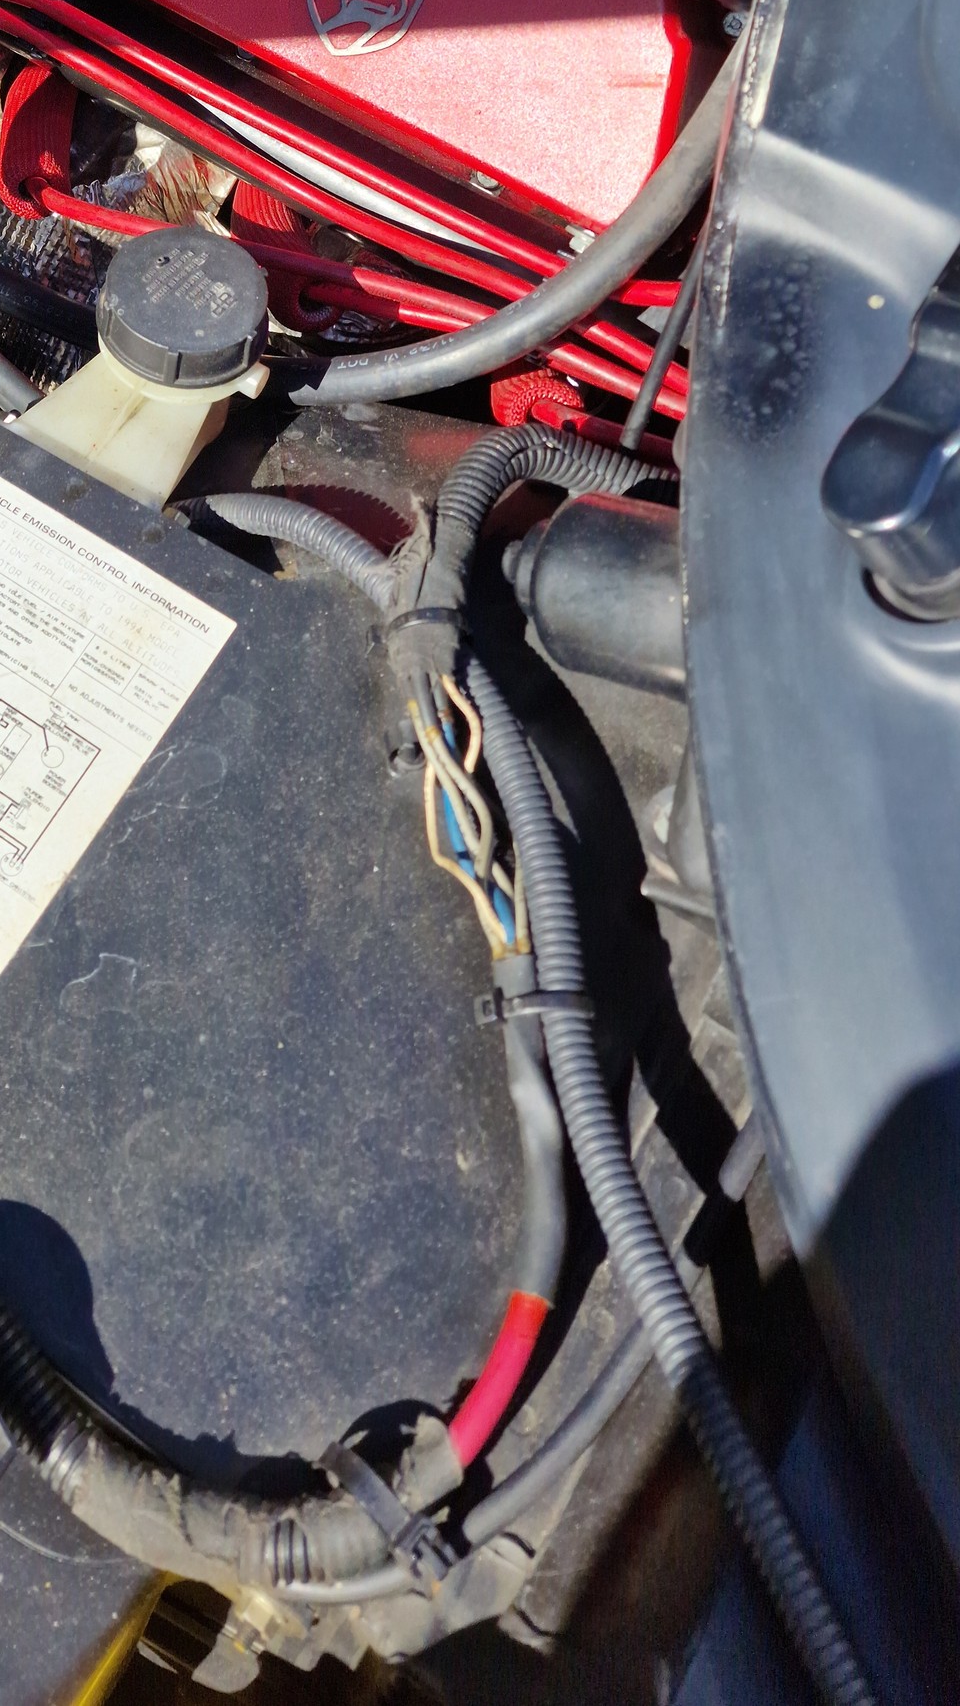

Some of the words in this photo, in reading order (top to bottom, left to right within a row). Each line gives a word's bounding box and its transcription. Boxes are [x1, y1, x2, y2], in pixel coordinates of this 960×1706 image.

[9, 527, 54, 559] VEHICLE
[56, 556, 108, 592] CONFORMS
[111, 590, 127, 604] TO
[158, 620, 182, 639] EPA
[21, 512, 77, 550] EMISSION
[76, 546, 131, 584] CONTROL
[130, 580, 211, 634] INFORMATION
[3, 623, 33, 645] APPROVED
[7, 606, 19, 616] AND
[20, 615, 39, 629] OTHER
[40, 628, 75, 653] ADDITIONAL
[22, 598, 38, 610] FUEL
[46, 613, 59, 623] AIR
[59, 621, 85, 640] MIXTURE
[25, 576, 76, 613] VEHICLES
[96, 622, 117, 639] ALL
[32, 560, 94, 604] APPLICABLE
[98, 602, 113, 616] TO
[116, 614, 143, 635] 1994
[145, 632, 180, 659] MODEL
[38, 617, 50, 627] THE
[51, 626, 76, 644] SERVICE
[67, 683, 78, 693] NO
[79, 691, 125, 723] ADJUSTMENTS
[126, 722, 152, 742] NEEDED
